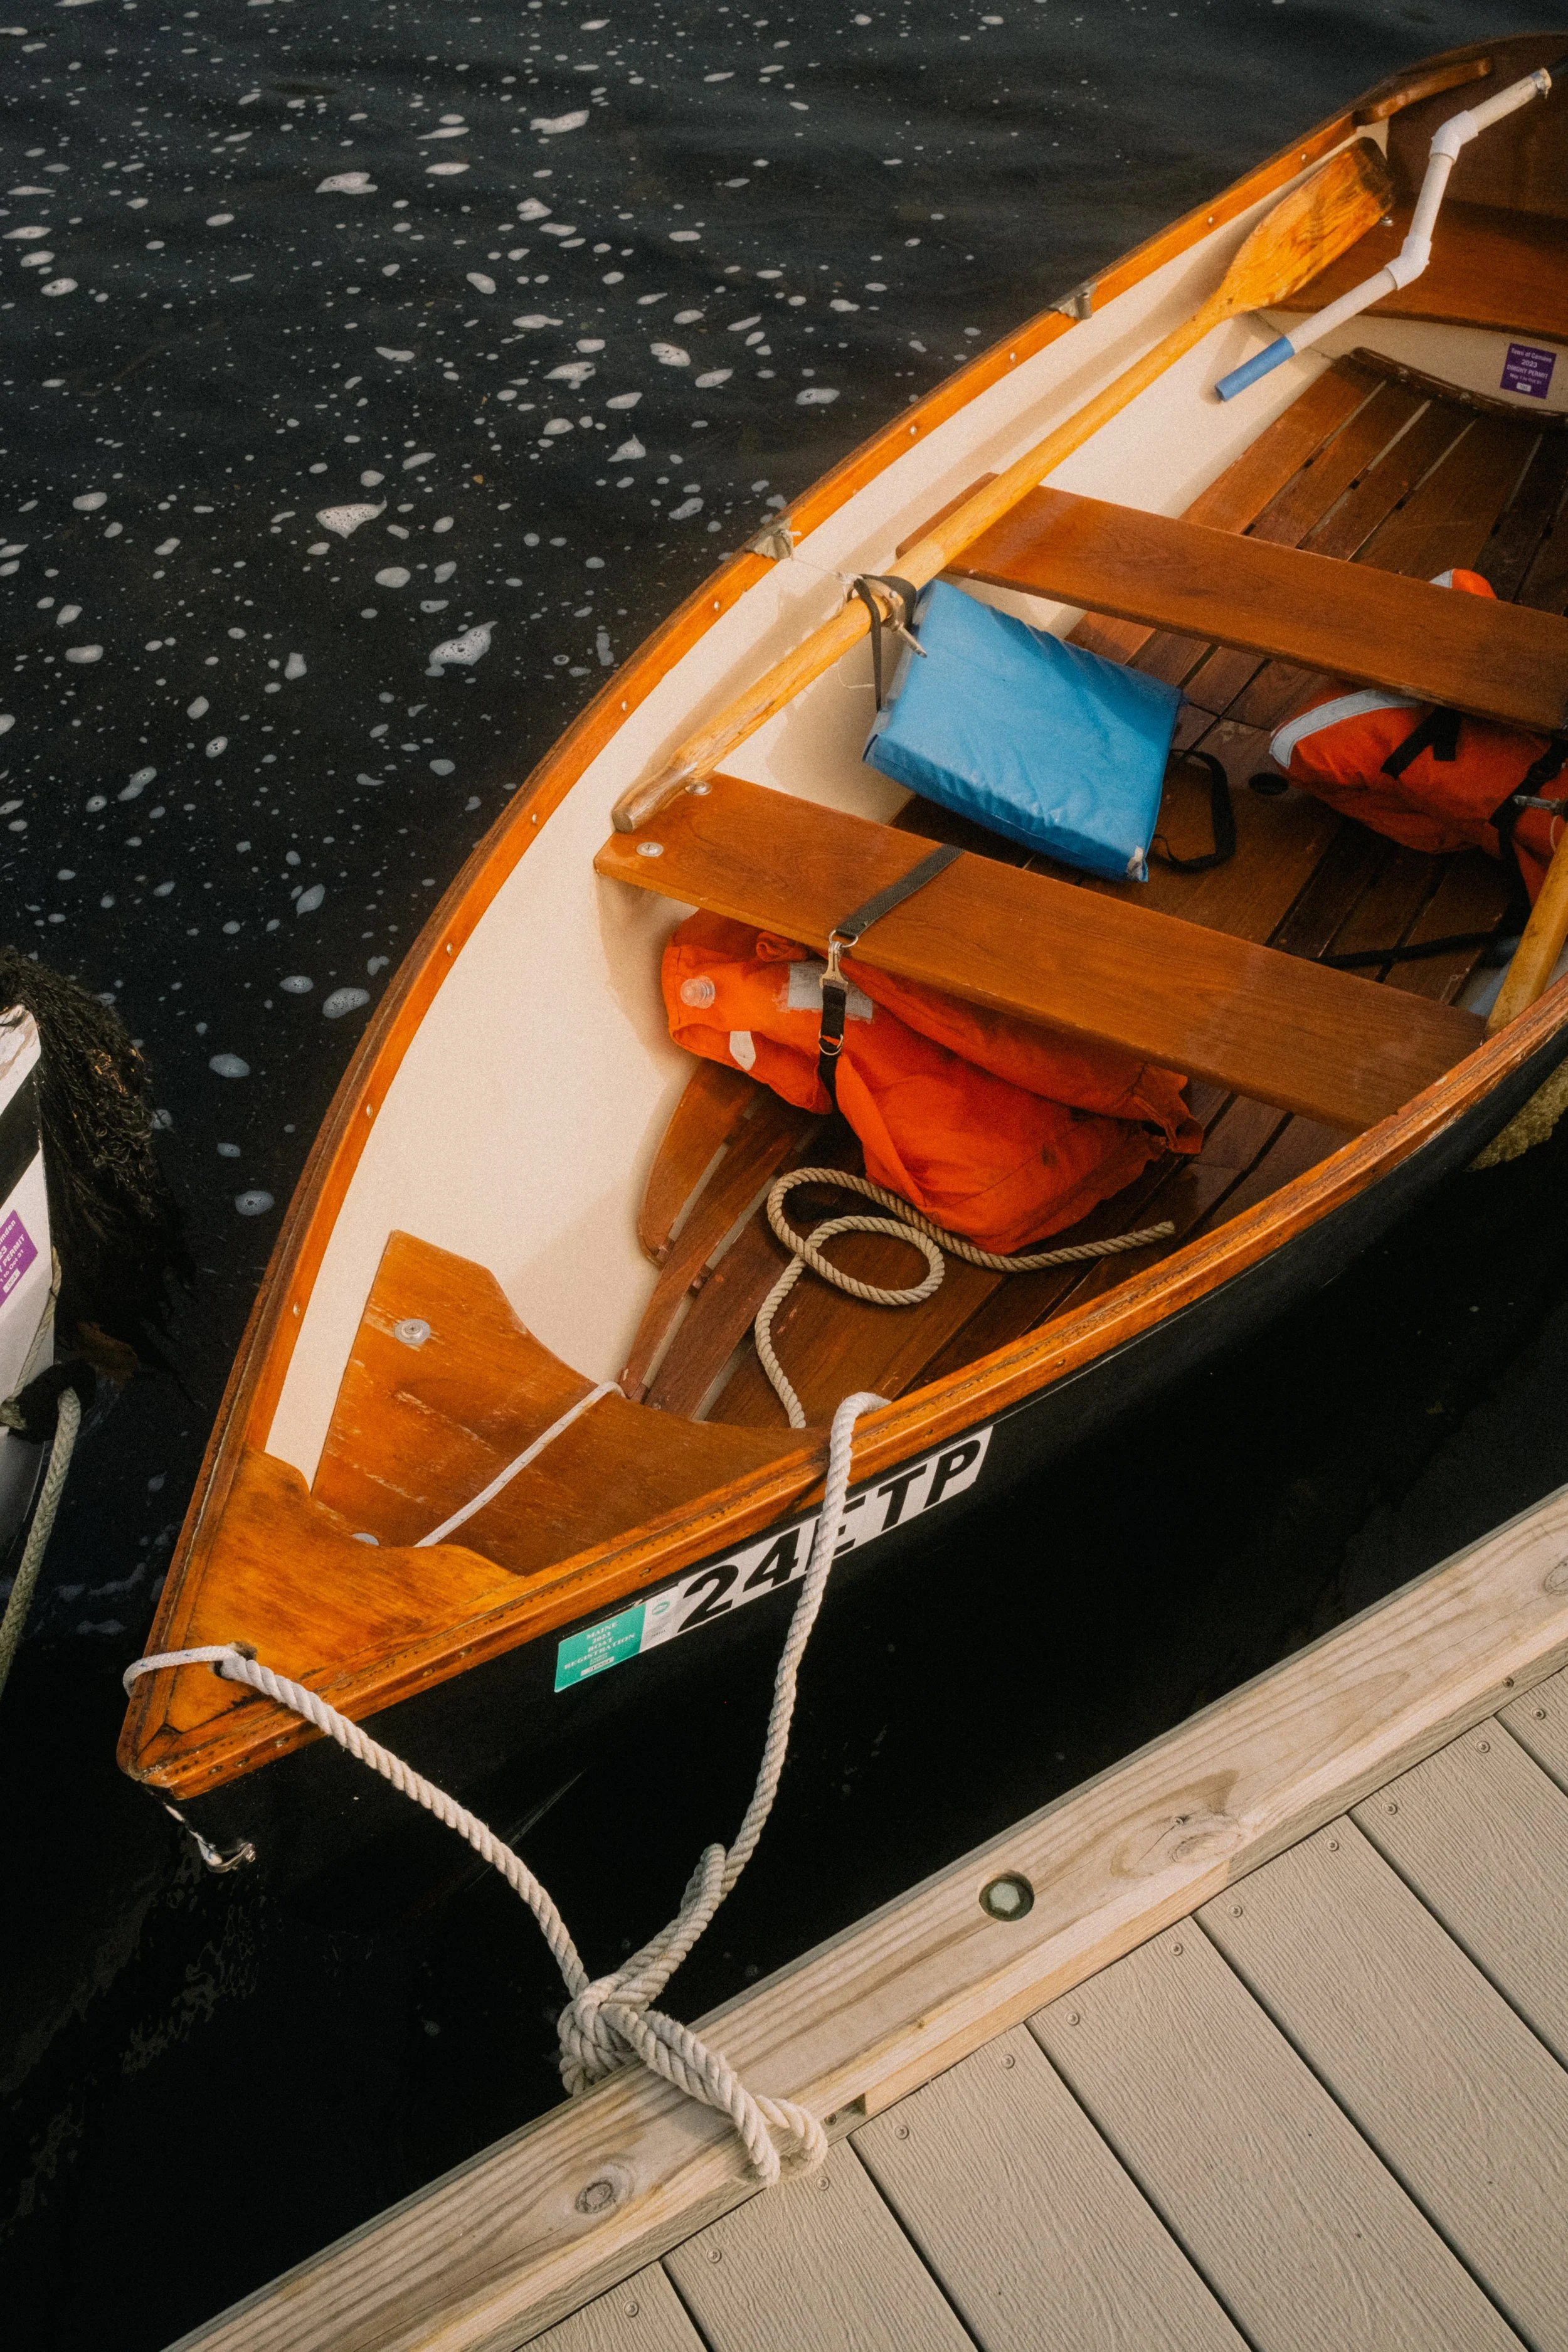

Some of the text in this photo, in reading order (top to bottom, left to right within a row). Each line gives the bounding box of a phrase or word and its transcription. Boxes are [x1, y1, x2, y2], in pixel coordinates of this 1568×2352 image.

[1521, 359, 1538, 368] 2023
[1528, 369, 1549, 379] PERMIT
[3, 1234, 24, 1267] PERMIT
[9, 1258, 19, 1270] Oct
[586, 1621, 617, 1640] MAINE
[564, 1633, 635, 1670] REGISTRATION
[588, 1637, 613, 1653] BOAT
